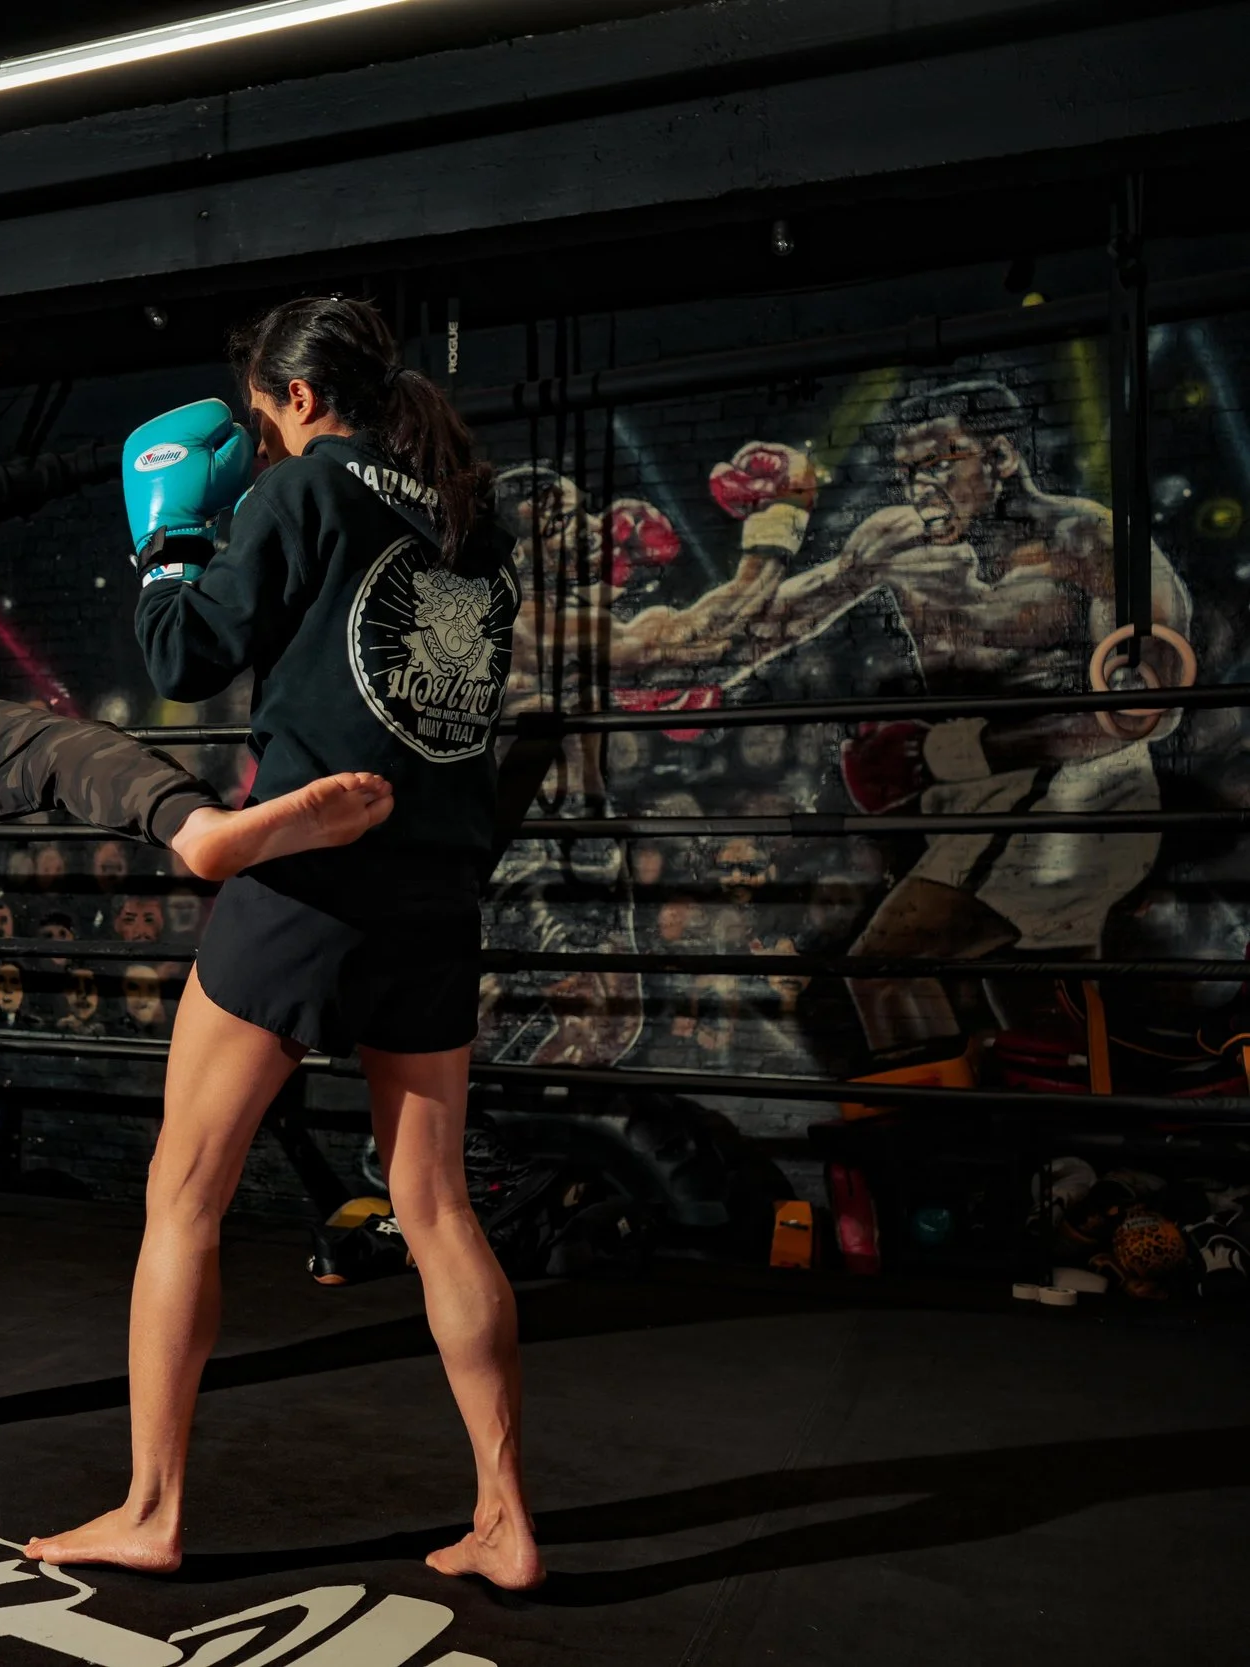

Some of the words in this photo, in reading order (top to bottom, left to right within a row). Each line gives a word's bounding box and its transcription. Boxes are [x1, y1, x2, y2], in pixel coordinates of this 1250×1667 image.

[448, 321, 459, 374] ROGUE
[140, 450, 182, 466] Winning
[443, 709, 460, 722] NICK
[417, 717, 443, 739] MUAY
[445, 722, 476, 743] THAI
